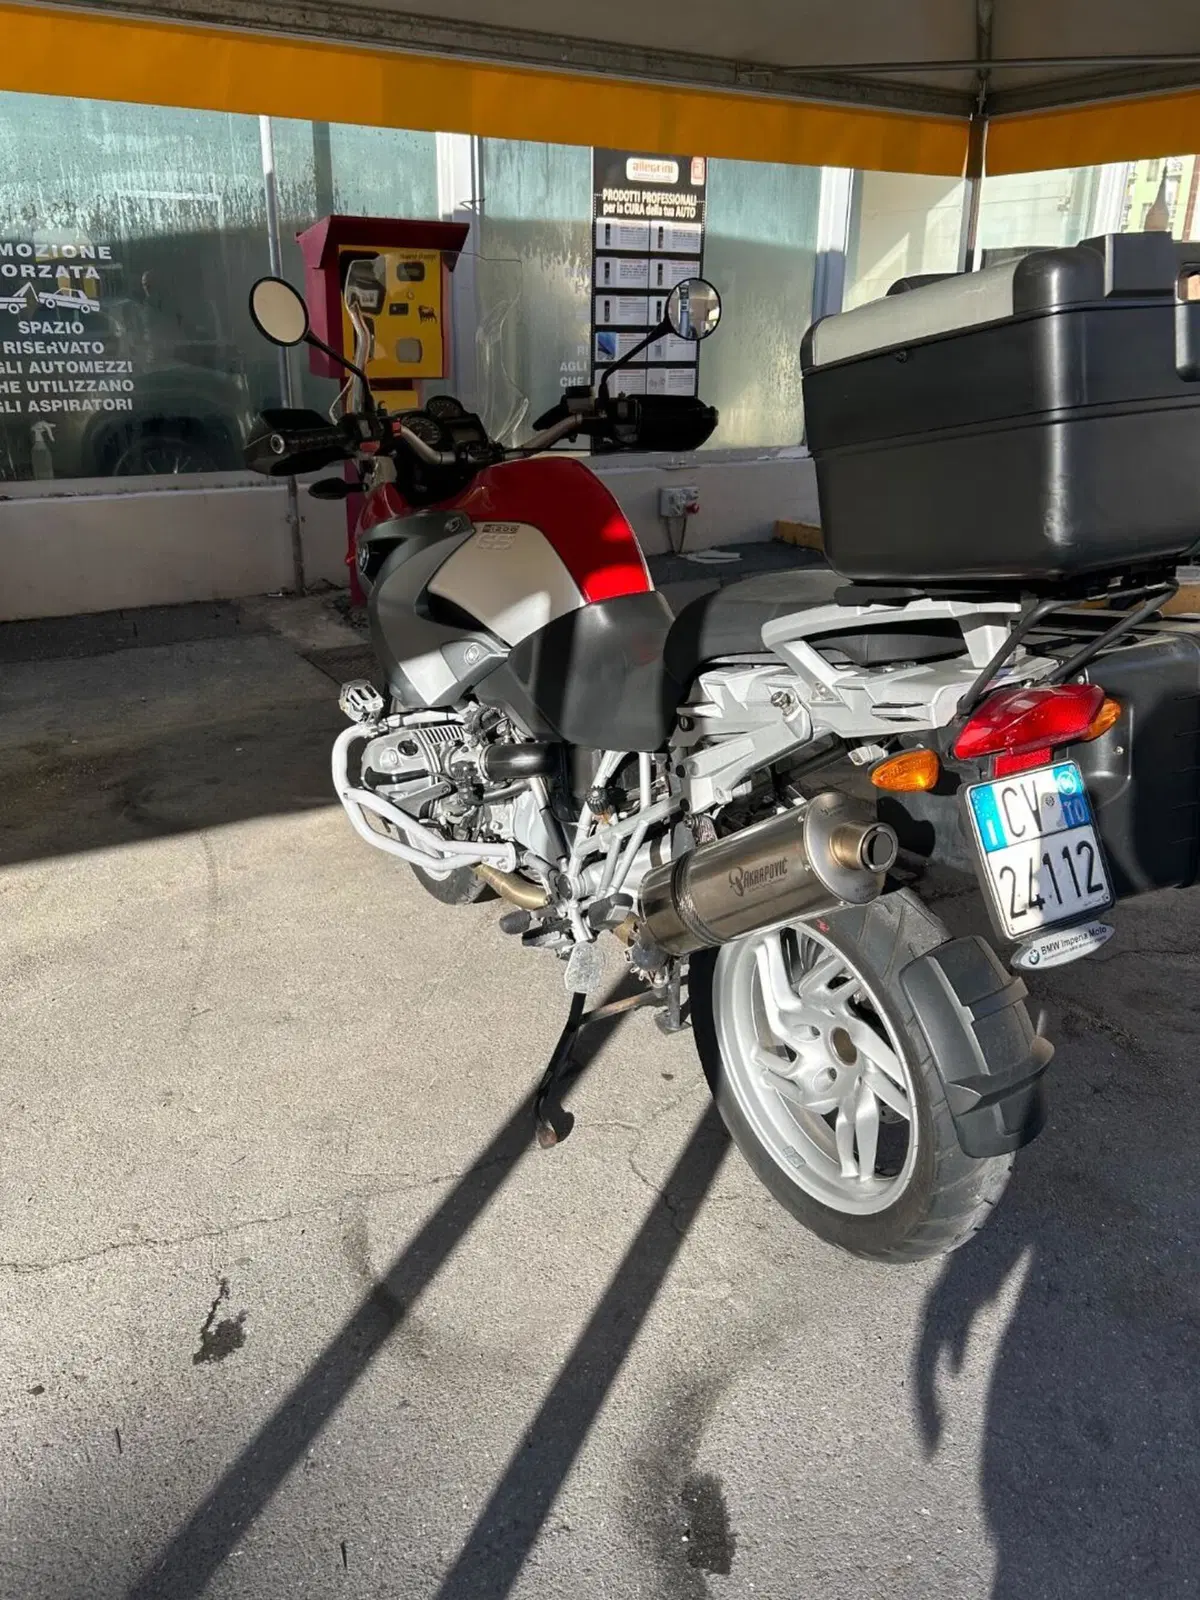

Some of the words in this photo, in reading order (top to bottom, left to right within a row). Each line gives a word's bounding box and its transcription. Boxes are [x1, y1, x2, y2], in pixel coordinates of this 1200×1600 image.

[602, 189, 641, 201] PRODOTTI
[642, 191, 697, 206] PROFESSIONALI
[603, 202, 616, 215] per
[617, 202, 623, 213] la
[624, 203, 644, 215] CURA
[646, 204, 662, 216] della
[663, 206, 675, 217] tua
[676, 206, 696, 218] AUTO
[0, 243, 112, 260] MOZIONE
[1, 264, 100, 280] ORZATA
[18, 321, 85, 335] SPAZIO
[3, 341, 105, 355] RISERVATO
[29, 361, 133, 374] AUTOMEZZI
[560, 361, 587, 372] AGLI
[27, 380, 134, 394] UTILIZZANO
[560, 377, 584, 388] CHE
[28, 399, 133, 413] ASPIRATORI
[1001, 780, 1043, 838] CV
[1063, 797, 1086, 825] TO
[1000, 840, 1104, 919] 24112
[1041, 941, 1060, 955] BMW
